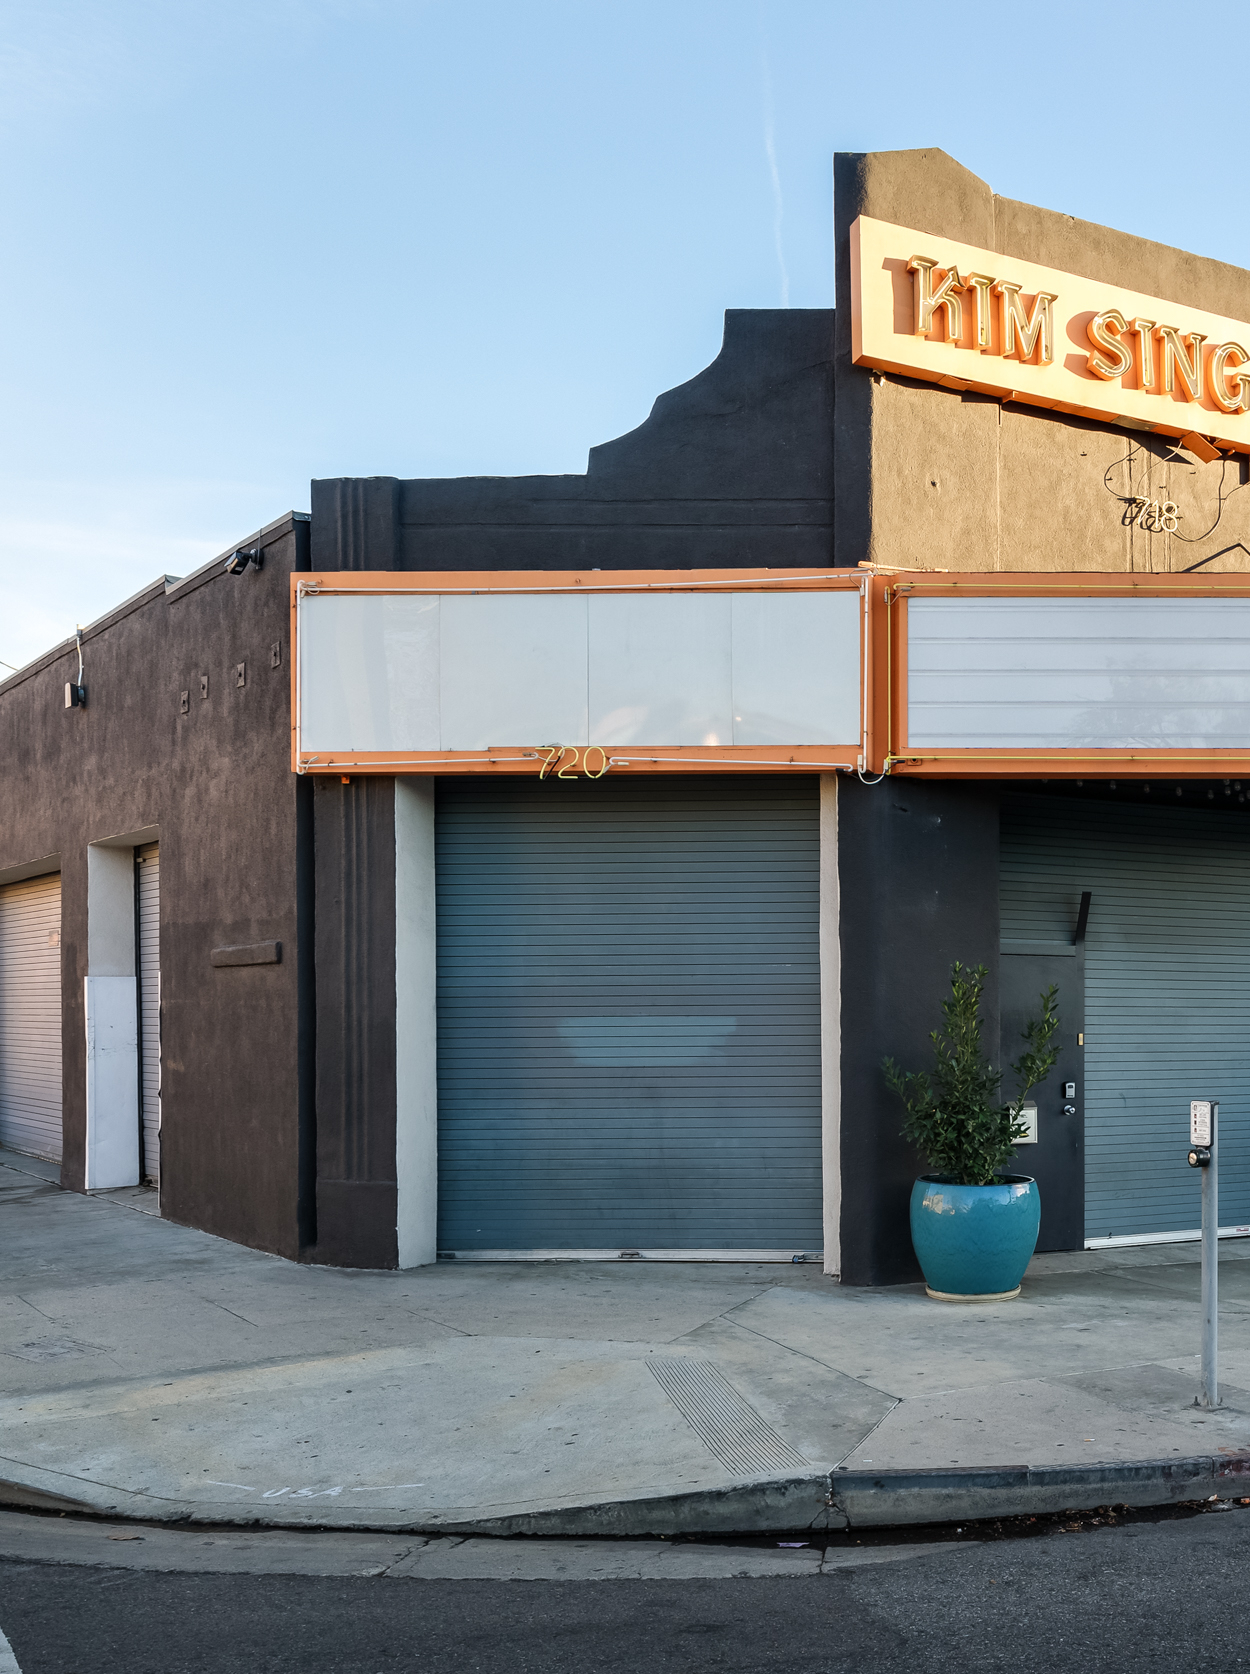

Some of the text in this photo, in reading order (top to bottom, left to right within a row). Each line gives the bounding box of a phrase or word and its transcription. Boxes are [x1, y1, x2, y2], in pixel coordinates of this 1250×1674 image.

[907, 254, 1058, 366] KIM
[1134, 496, 1178, 532] 718
[535, 746, 606, 779] 720
[262, 1485, 345, 1498] USA
